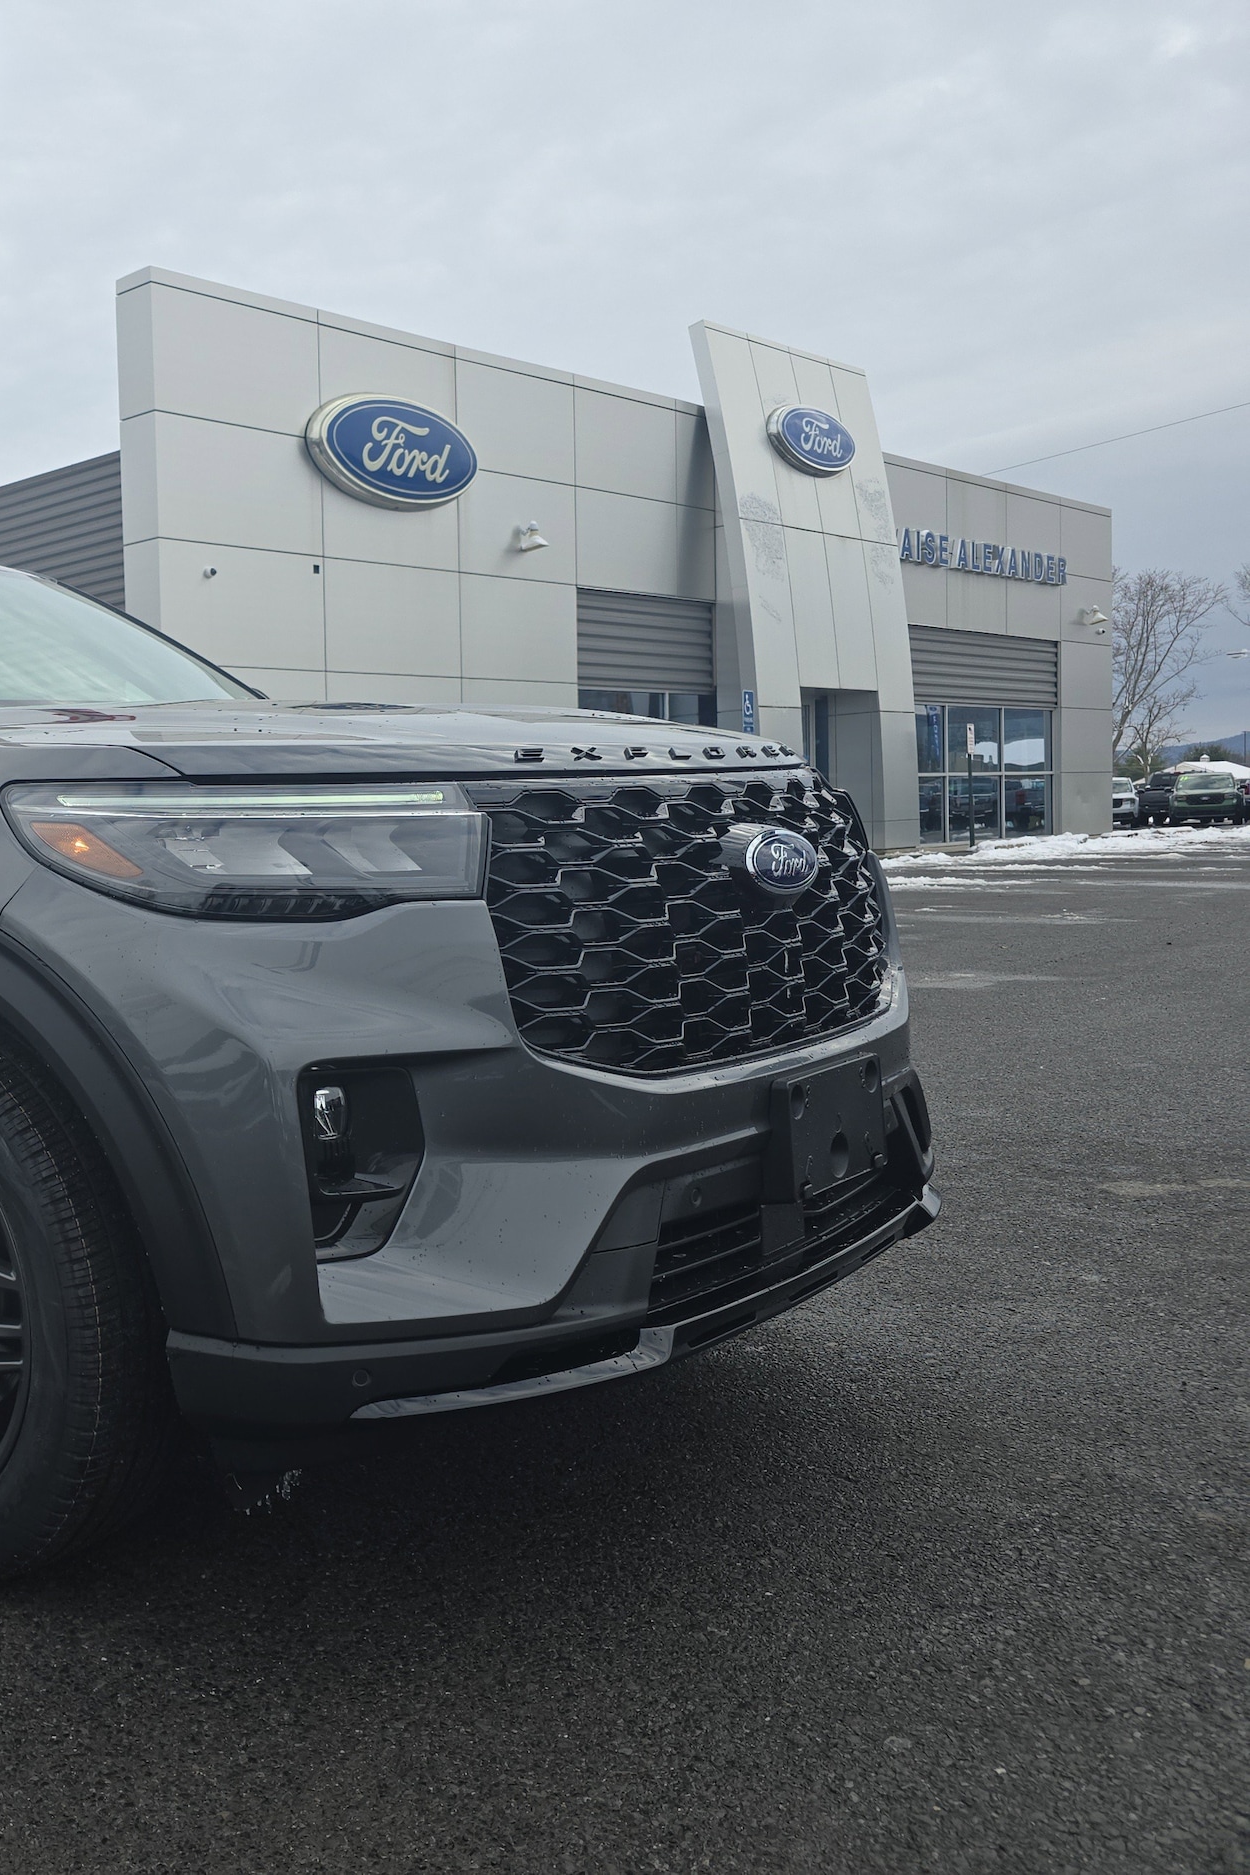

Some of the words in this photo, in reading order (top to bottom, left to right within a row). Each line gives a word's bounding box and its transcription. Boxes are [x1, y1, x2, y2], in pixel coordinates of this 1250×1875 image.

[362, 416, 451, 484] Ford
[800, 417, 843, 458] Ford
[900, 527, 949, 567] AISE
[956, 538, 1068, 585] ALEXANDER
[513, 745, 794, 763] EXPLORER
[770, 843, 809, 878] Ford
